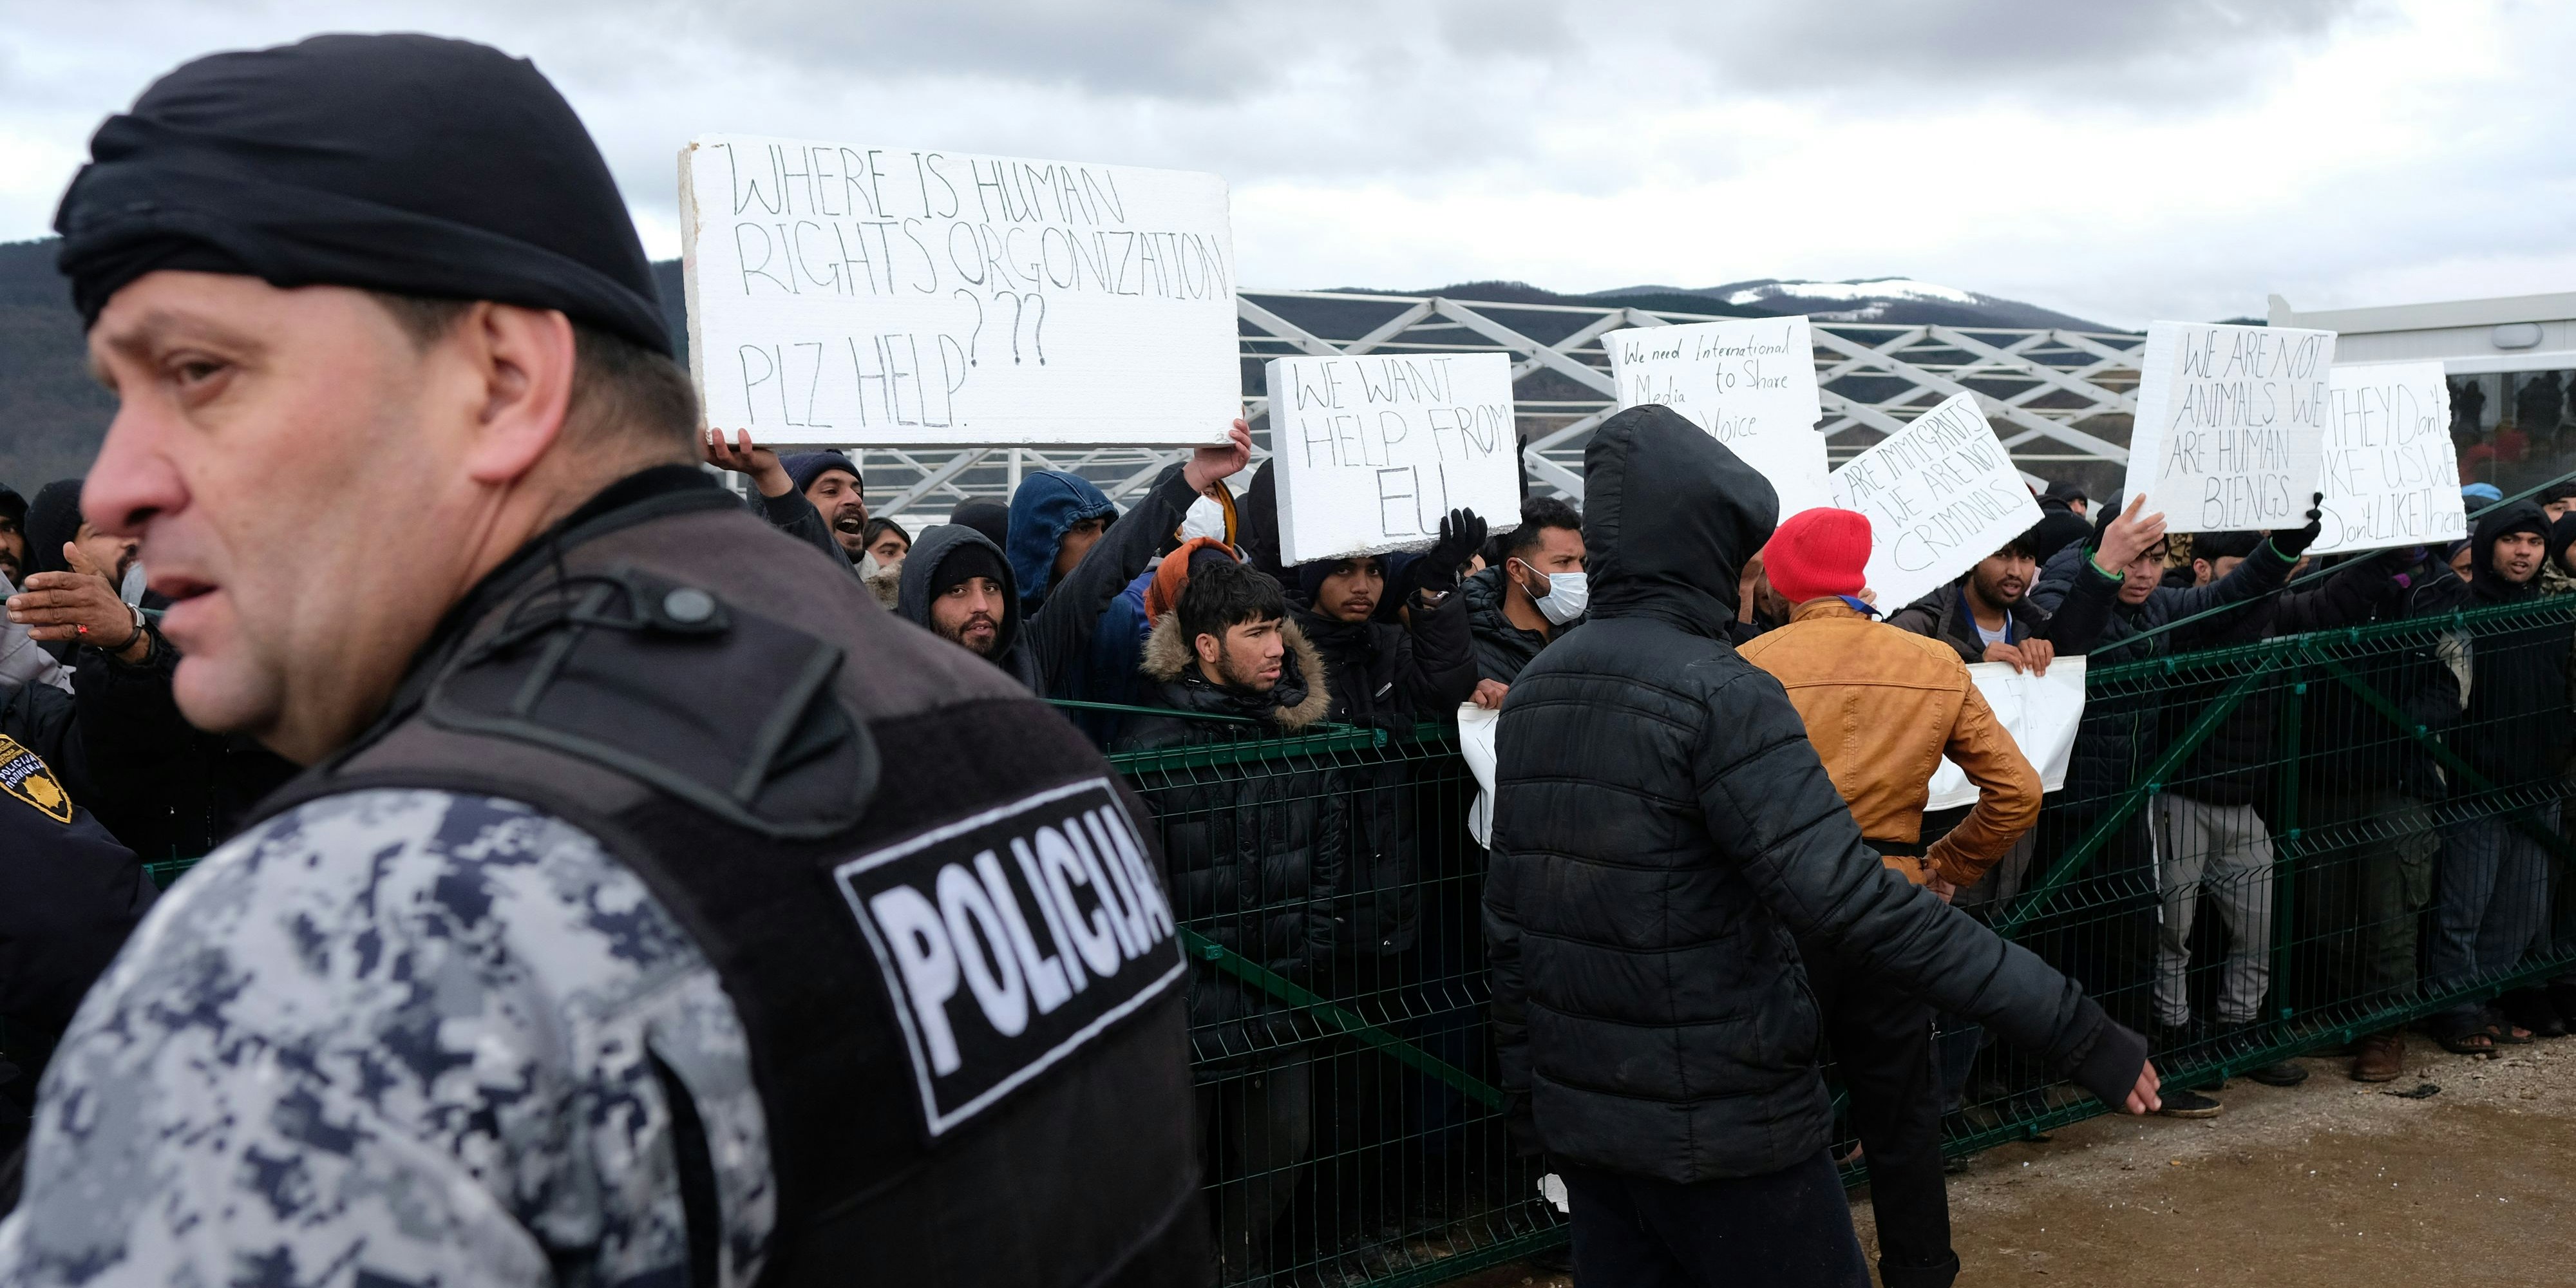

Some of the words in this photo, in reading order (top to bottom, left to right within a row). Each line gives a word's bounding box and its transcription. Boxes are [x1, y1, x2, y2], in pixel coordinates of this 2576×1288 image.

[726, 142, 895, 217] WHERE
[911, 152, 958, 219] IS
[971, 159, 1126, 225] HUMAN
[735, 218, 938, 295] RIGHTS
[948, 221, 1228, 300] ORGONIZATION
[1624, 341, 1645, 365] We
[1652, 338, 1683, 359] need
[1695, 325, 1792, 361] International
[2184, 330, 2217, 378] WE
[2223, 331, 2269, 378] ARE
[2270, 334, 2329, 379] NOT
[739, 342, 833, 428] PLZ
[1293, 361, 1345, 410] WE
[1355, 358, 1452, 404] WANT
[1635, 374, 1686, 406] Media
[1716, 362, 1736, 394] to
[1743, 358, 1788, 390] Share
[2290, 382, 2325, 428] WE
[1301, 410, 1408, 468] HELP
[1428, 404, 1517, 461] FROM
[1699, 407, 1757, 443] Voice
[2330, 385, 2391, 447] THEY
[2164, 431, 2206, 479] ARE
[2219, 428, 2289, 473] HUMAN
[2321, 449, 2368, 499] IKE
[2420, 442, 2459, 488] WE
[1376, 462, 1453, 538] EU
[1844, 459, 1886, 507] ARE
[1876, 486, 1923, 529] WE
[1920, 456, 1974, 501] ARE
[1956, 432, 2005, 476] NOT
[2375, 492, 2419, 540] LIKE
[2420, 488, 2467, 536] Them
[0, 753, 37, 781] POLICIJA
[869, 804, 1177, 1077] POLICIJA
